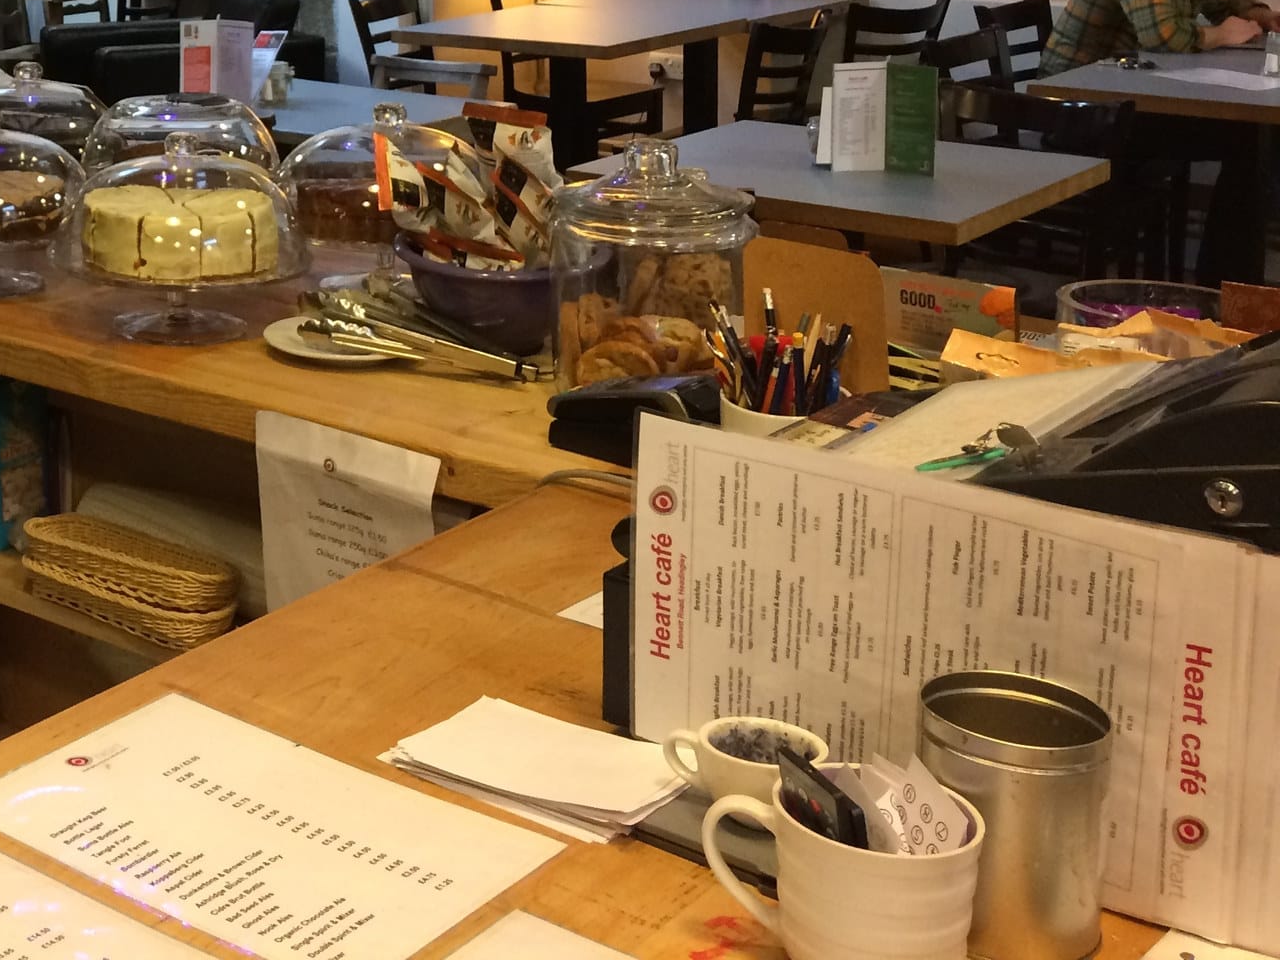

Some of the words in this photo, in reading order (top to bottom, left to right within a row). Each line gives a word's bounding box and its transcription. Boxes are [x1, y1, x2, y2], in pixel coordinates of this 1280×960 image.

[663, 441, 679, 485] heart
[651, 533, 672, 585] café
[1016, 568, 1026, 616] Mediterranean
[1021, 530, 1029, 565] Vegetables
[1088, 571, 1096, 594] Potato
[1086, 596, 1094, 616] Sweet
[650, 592, 671, 660] Heart
[903, 636, 912, 676] Sandwiches
[1182, 643, 1213, 725] Heart
[1180, 733, 1208, 796] café
[50, 822, 77, 838] Draught
[77, 815, 93, 824] Keg
[91, 807, 107, 816] Beer
[64, 833, 85, 845] Bottle
[85, 822, 104, 834] Lager
[97, 828, 118, 841] Bottle
[118, 820, 135, 829] Ales
[91, 844, 116, 858] Tangle
[115, 835, 132, 845] Foot
[128, 840, 150, 852] Ferret
[185, 853, 204, 864] Cider
[268, 854, 283, 863] Dry
[120, 849, 159, 872] Bombardier
[135, 859, 170, 879] Raspberry
[169, 851, 182, 859] Ale
[179, 877, 219, 900] Dunkertons
[245, 850, 263, 860] Cider
[184, 870, 203, 881] Cider
[228, 893, 246, 904] Brut
[243, 881, 265, 894] Bottle
[226, 912, 242, 922] Bad
[240, 901, 258, 913] Seed
[258, 893, 274, 902] Ales
[242, 915, 264, 929] Ghost
[263, 905, 280, 915] Ales
[274, 925, 303, 943] Organic
[301, 905, 334, 925] Chocolate
[333, 898, 346, 906] Ale
[277, 913, 293, 924] Ales
[291, 936, 314, 951] Single
[312, 924, 333, 936] Spirit
[336, 908, 355, 921] Mixer
[307, 941, 334, 958] Double
[331, 929, 352, 942] Spirit
[355, 914, 375, 925] Mixer
